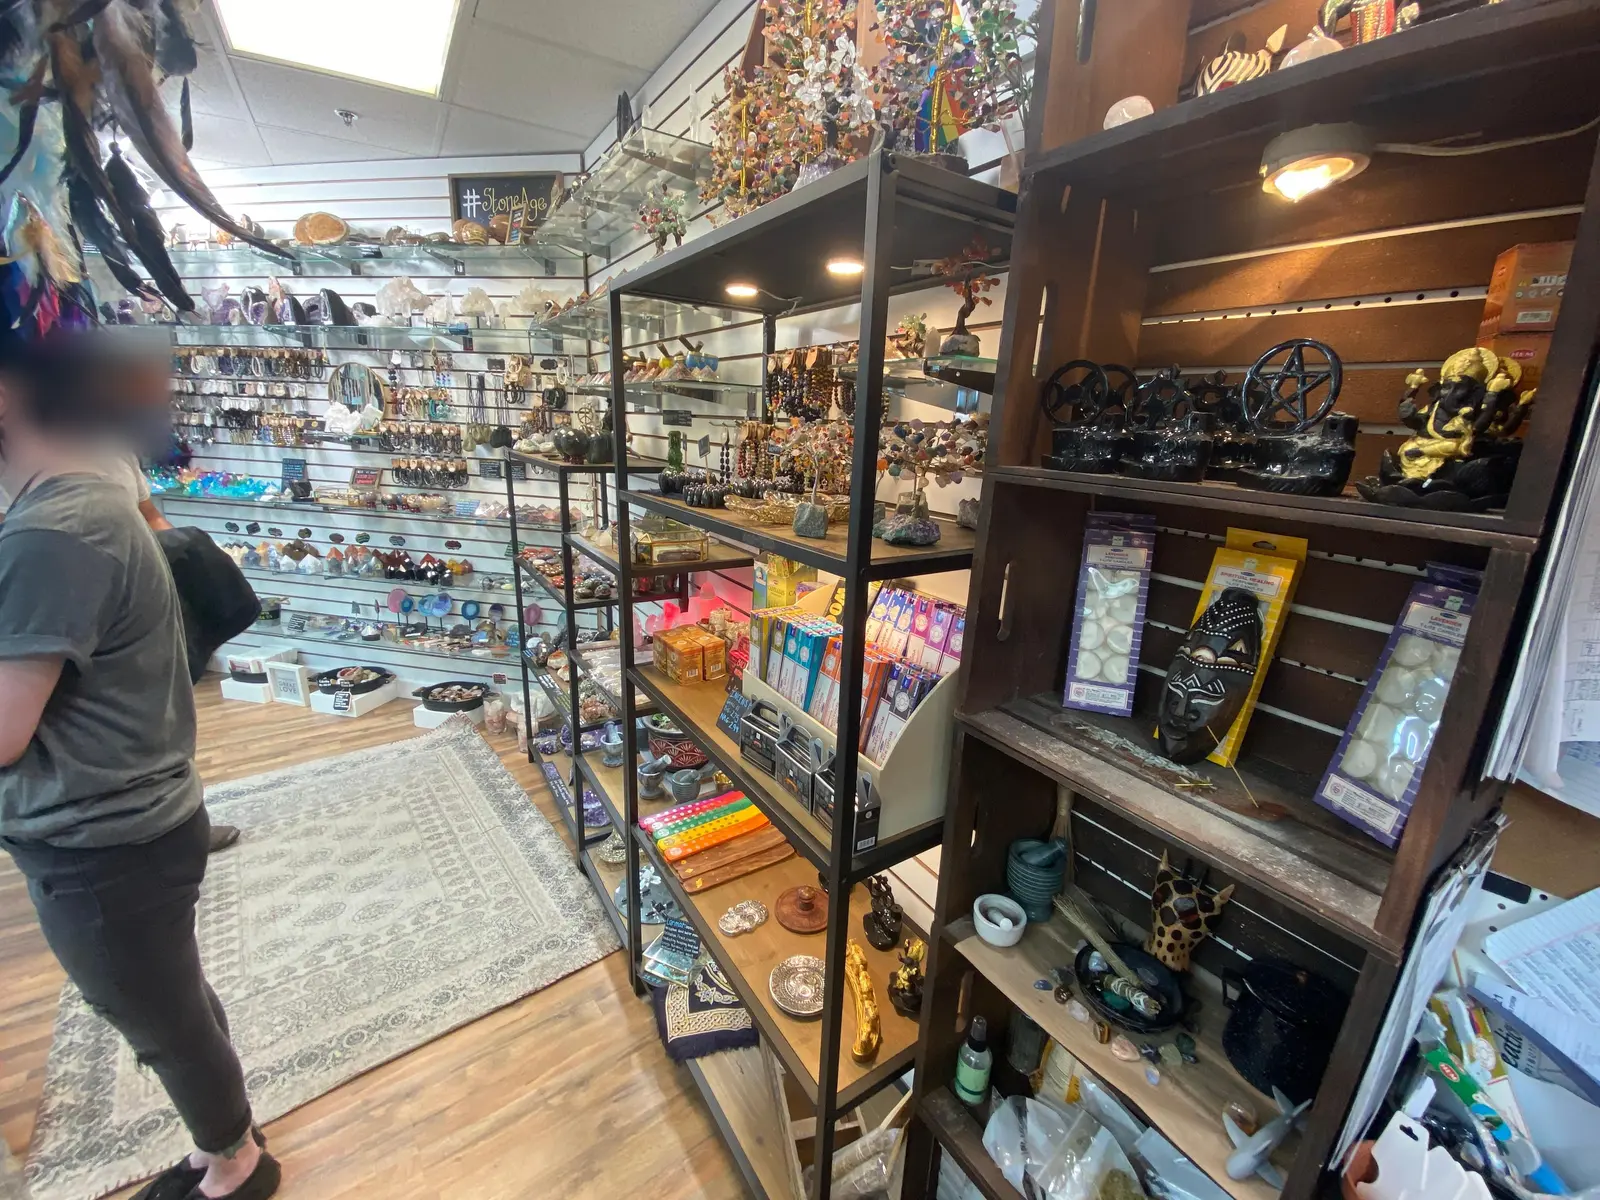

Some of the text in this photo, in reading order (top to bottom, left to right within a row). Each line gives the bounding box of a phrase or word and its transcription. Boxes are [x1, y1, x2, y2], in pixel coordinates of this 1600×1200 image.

[463, 186, 547, 221] #StoneAge
[1220, 571, 1275, 586] SPIRITUAL HEALING
[1430, 616, 1463, 627] LAVENDER
[1440, 1063, 1459, 1081] HEM
